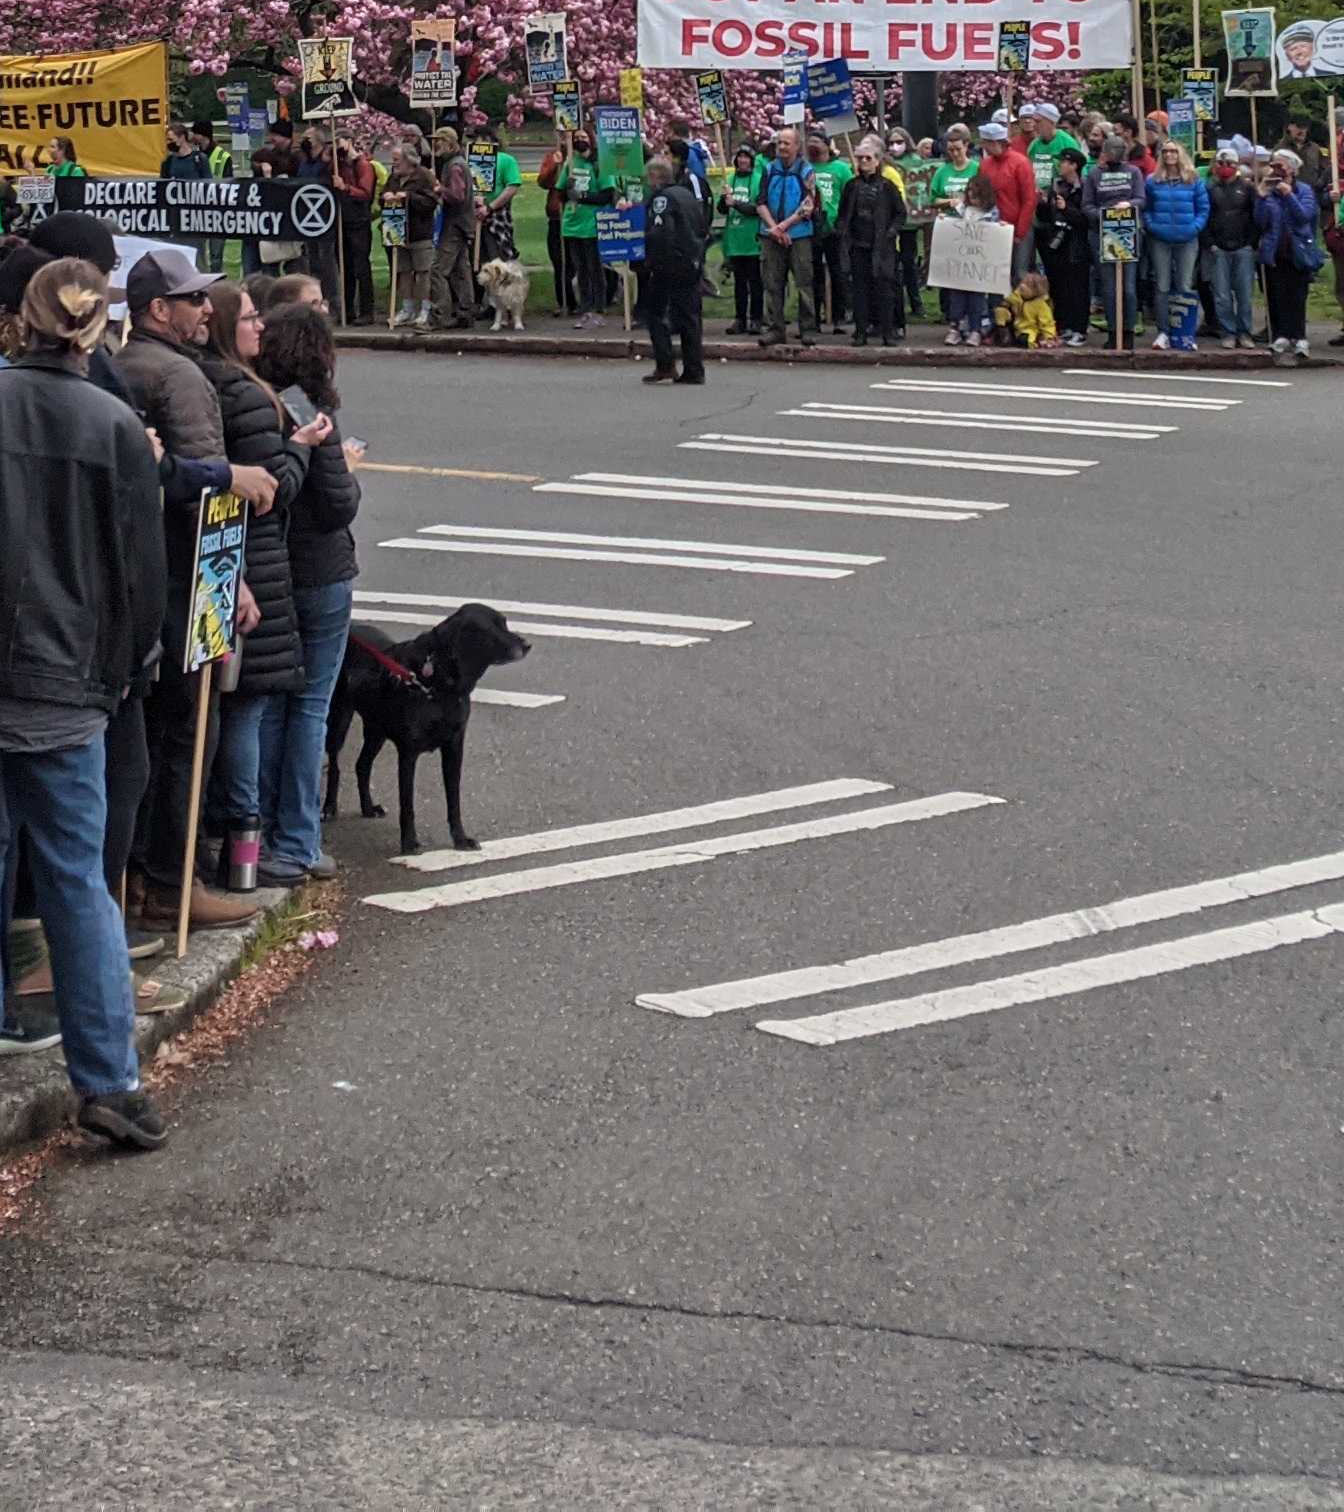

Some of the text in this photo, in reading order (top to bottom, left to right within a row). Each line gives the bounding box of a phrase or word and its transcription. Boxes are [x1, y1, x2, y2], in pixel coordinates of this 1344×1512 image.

[681, 18, 1082, 61] FOSSIL FUES!
[414, 79, 452, 89] WATER
[599, 118, 637, 129] BIDEN
[84, 180, 262, 207] DECLARE CLIMATE &
[180, 209, 284, 235] EMERGENCY
[207, 493, 241, 525] PEOPLE
[200, 524, 244, 556] FOSSIL FUELS
